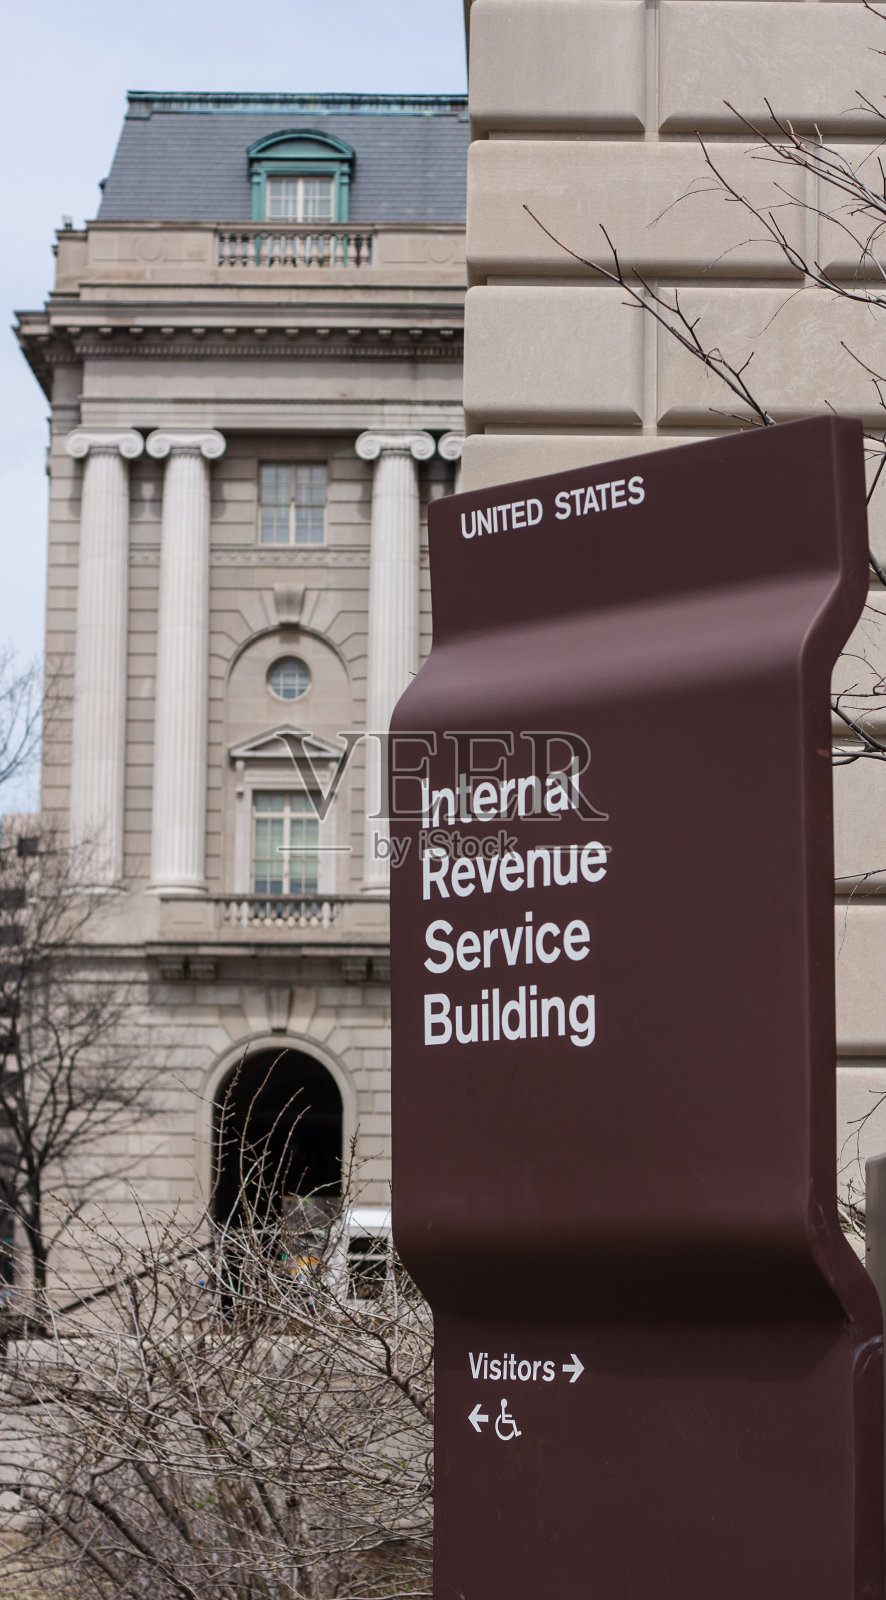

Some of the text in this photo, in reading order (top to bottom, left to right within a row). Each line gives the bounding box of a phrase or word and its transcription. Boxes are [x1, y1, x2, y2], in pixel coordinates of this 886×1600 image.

[460, 475, 646, 539] UNITED STATES
[421, 755, 580, 829] Internal
[422, 841, 608, 900] Revenue
[423, 911, 591, 974] Service
[424, 985, 596, 1047] Building
[468, 1352, 556, 1382] Visitors
